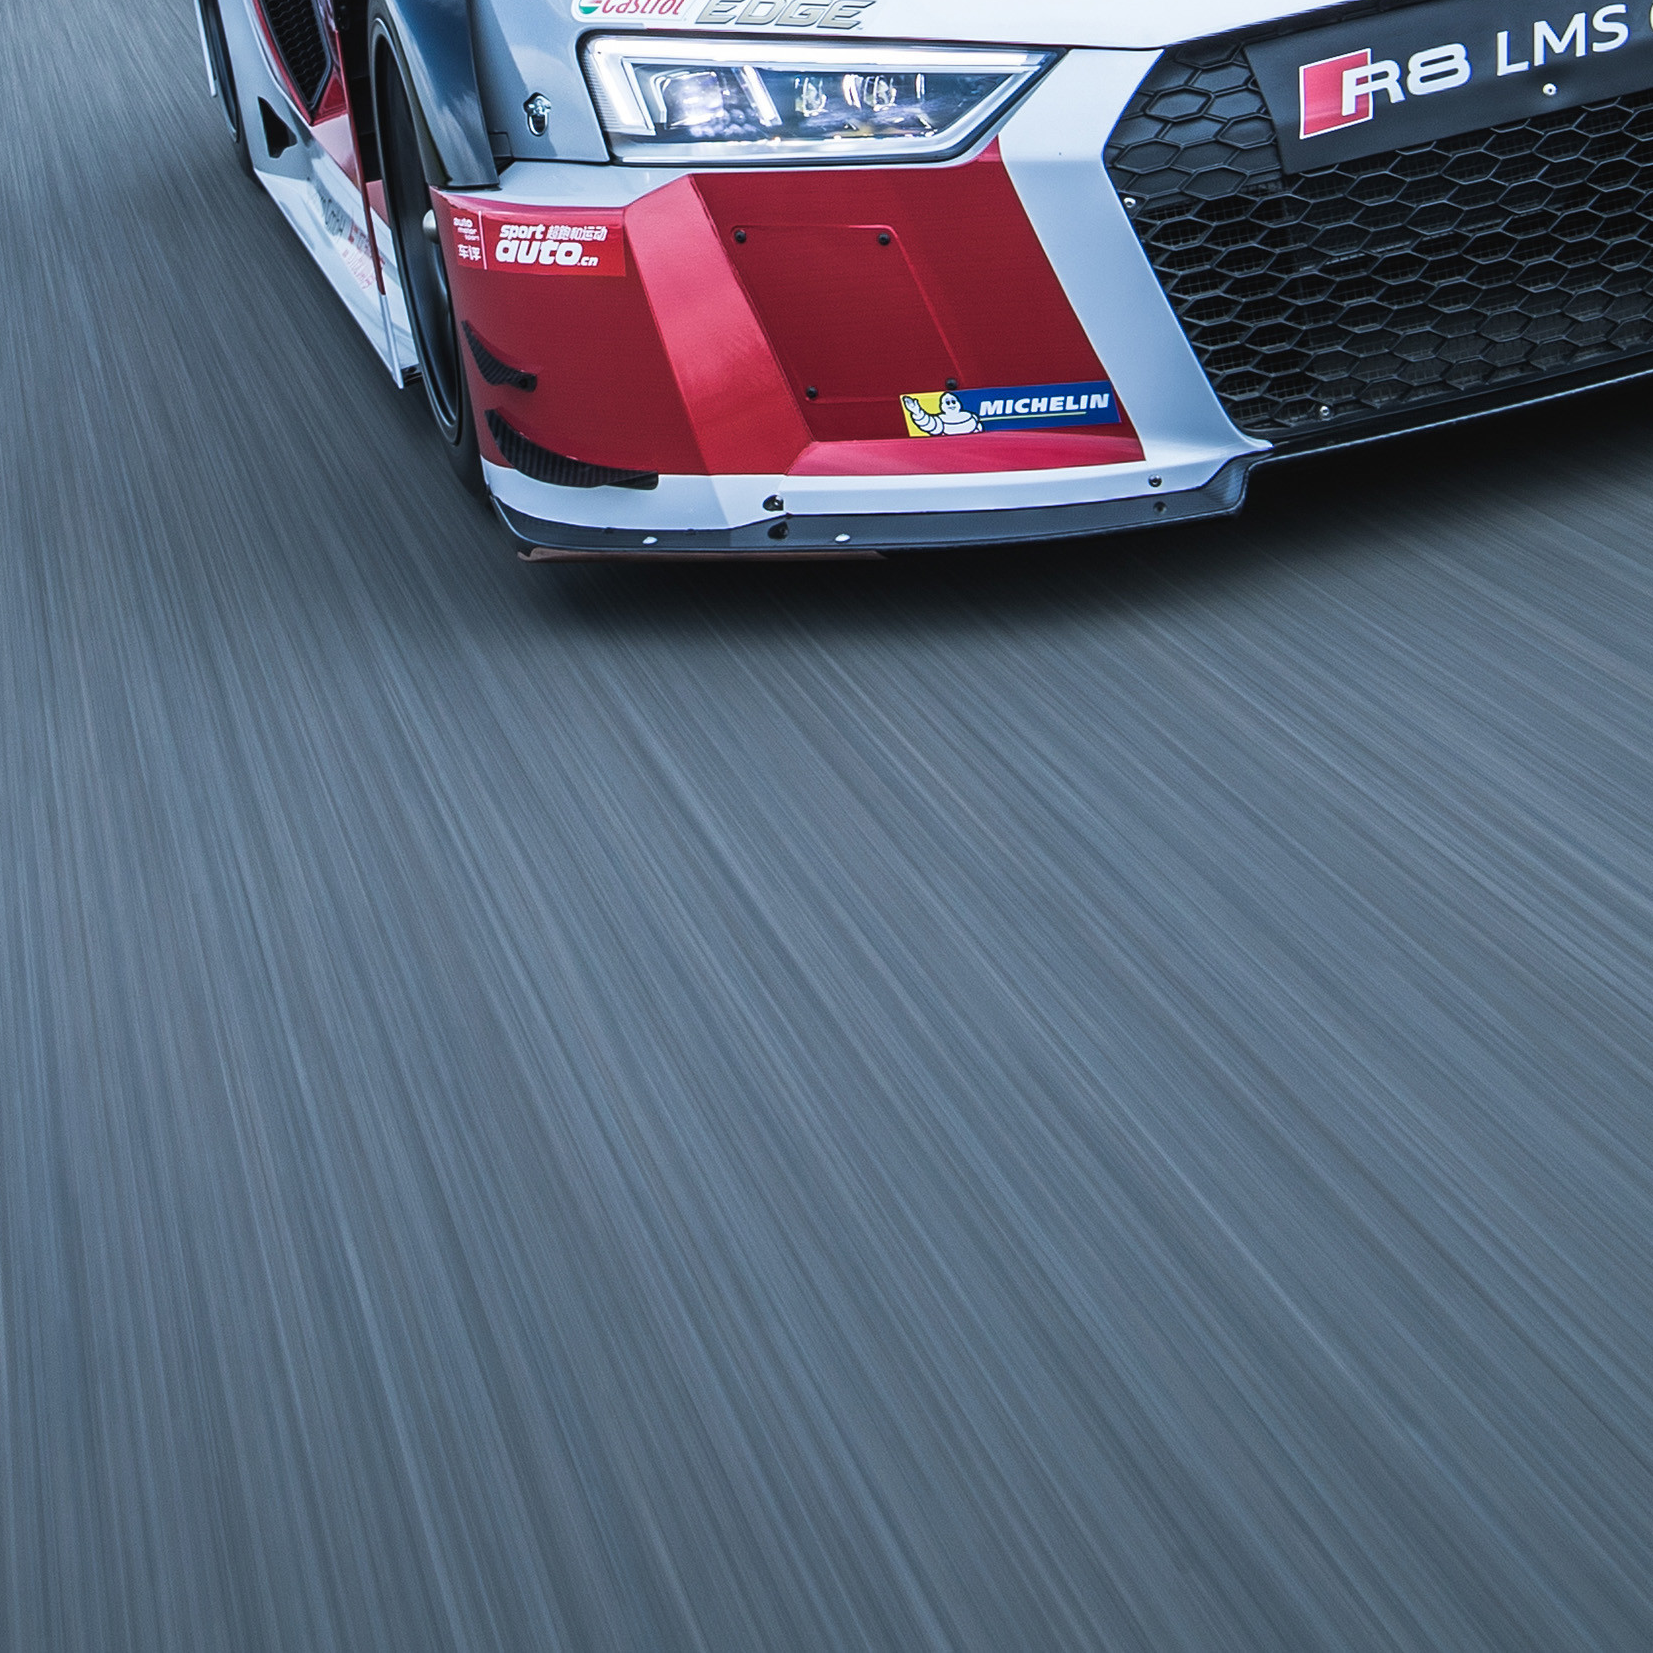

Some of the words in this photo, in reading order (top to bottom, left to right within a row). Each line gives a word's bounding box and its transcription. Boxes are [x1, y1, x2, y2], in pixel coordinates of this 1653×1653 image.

[1341, 42, 1471, 116] R8
[1496, 4, 1630, 77] LMS
[499, 223, 546, 240] sport
[495, 239, 599, 267] auto.cn
[979, 393, 1110, 416] MICHELIN
